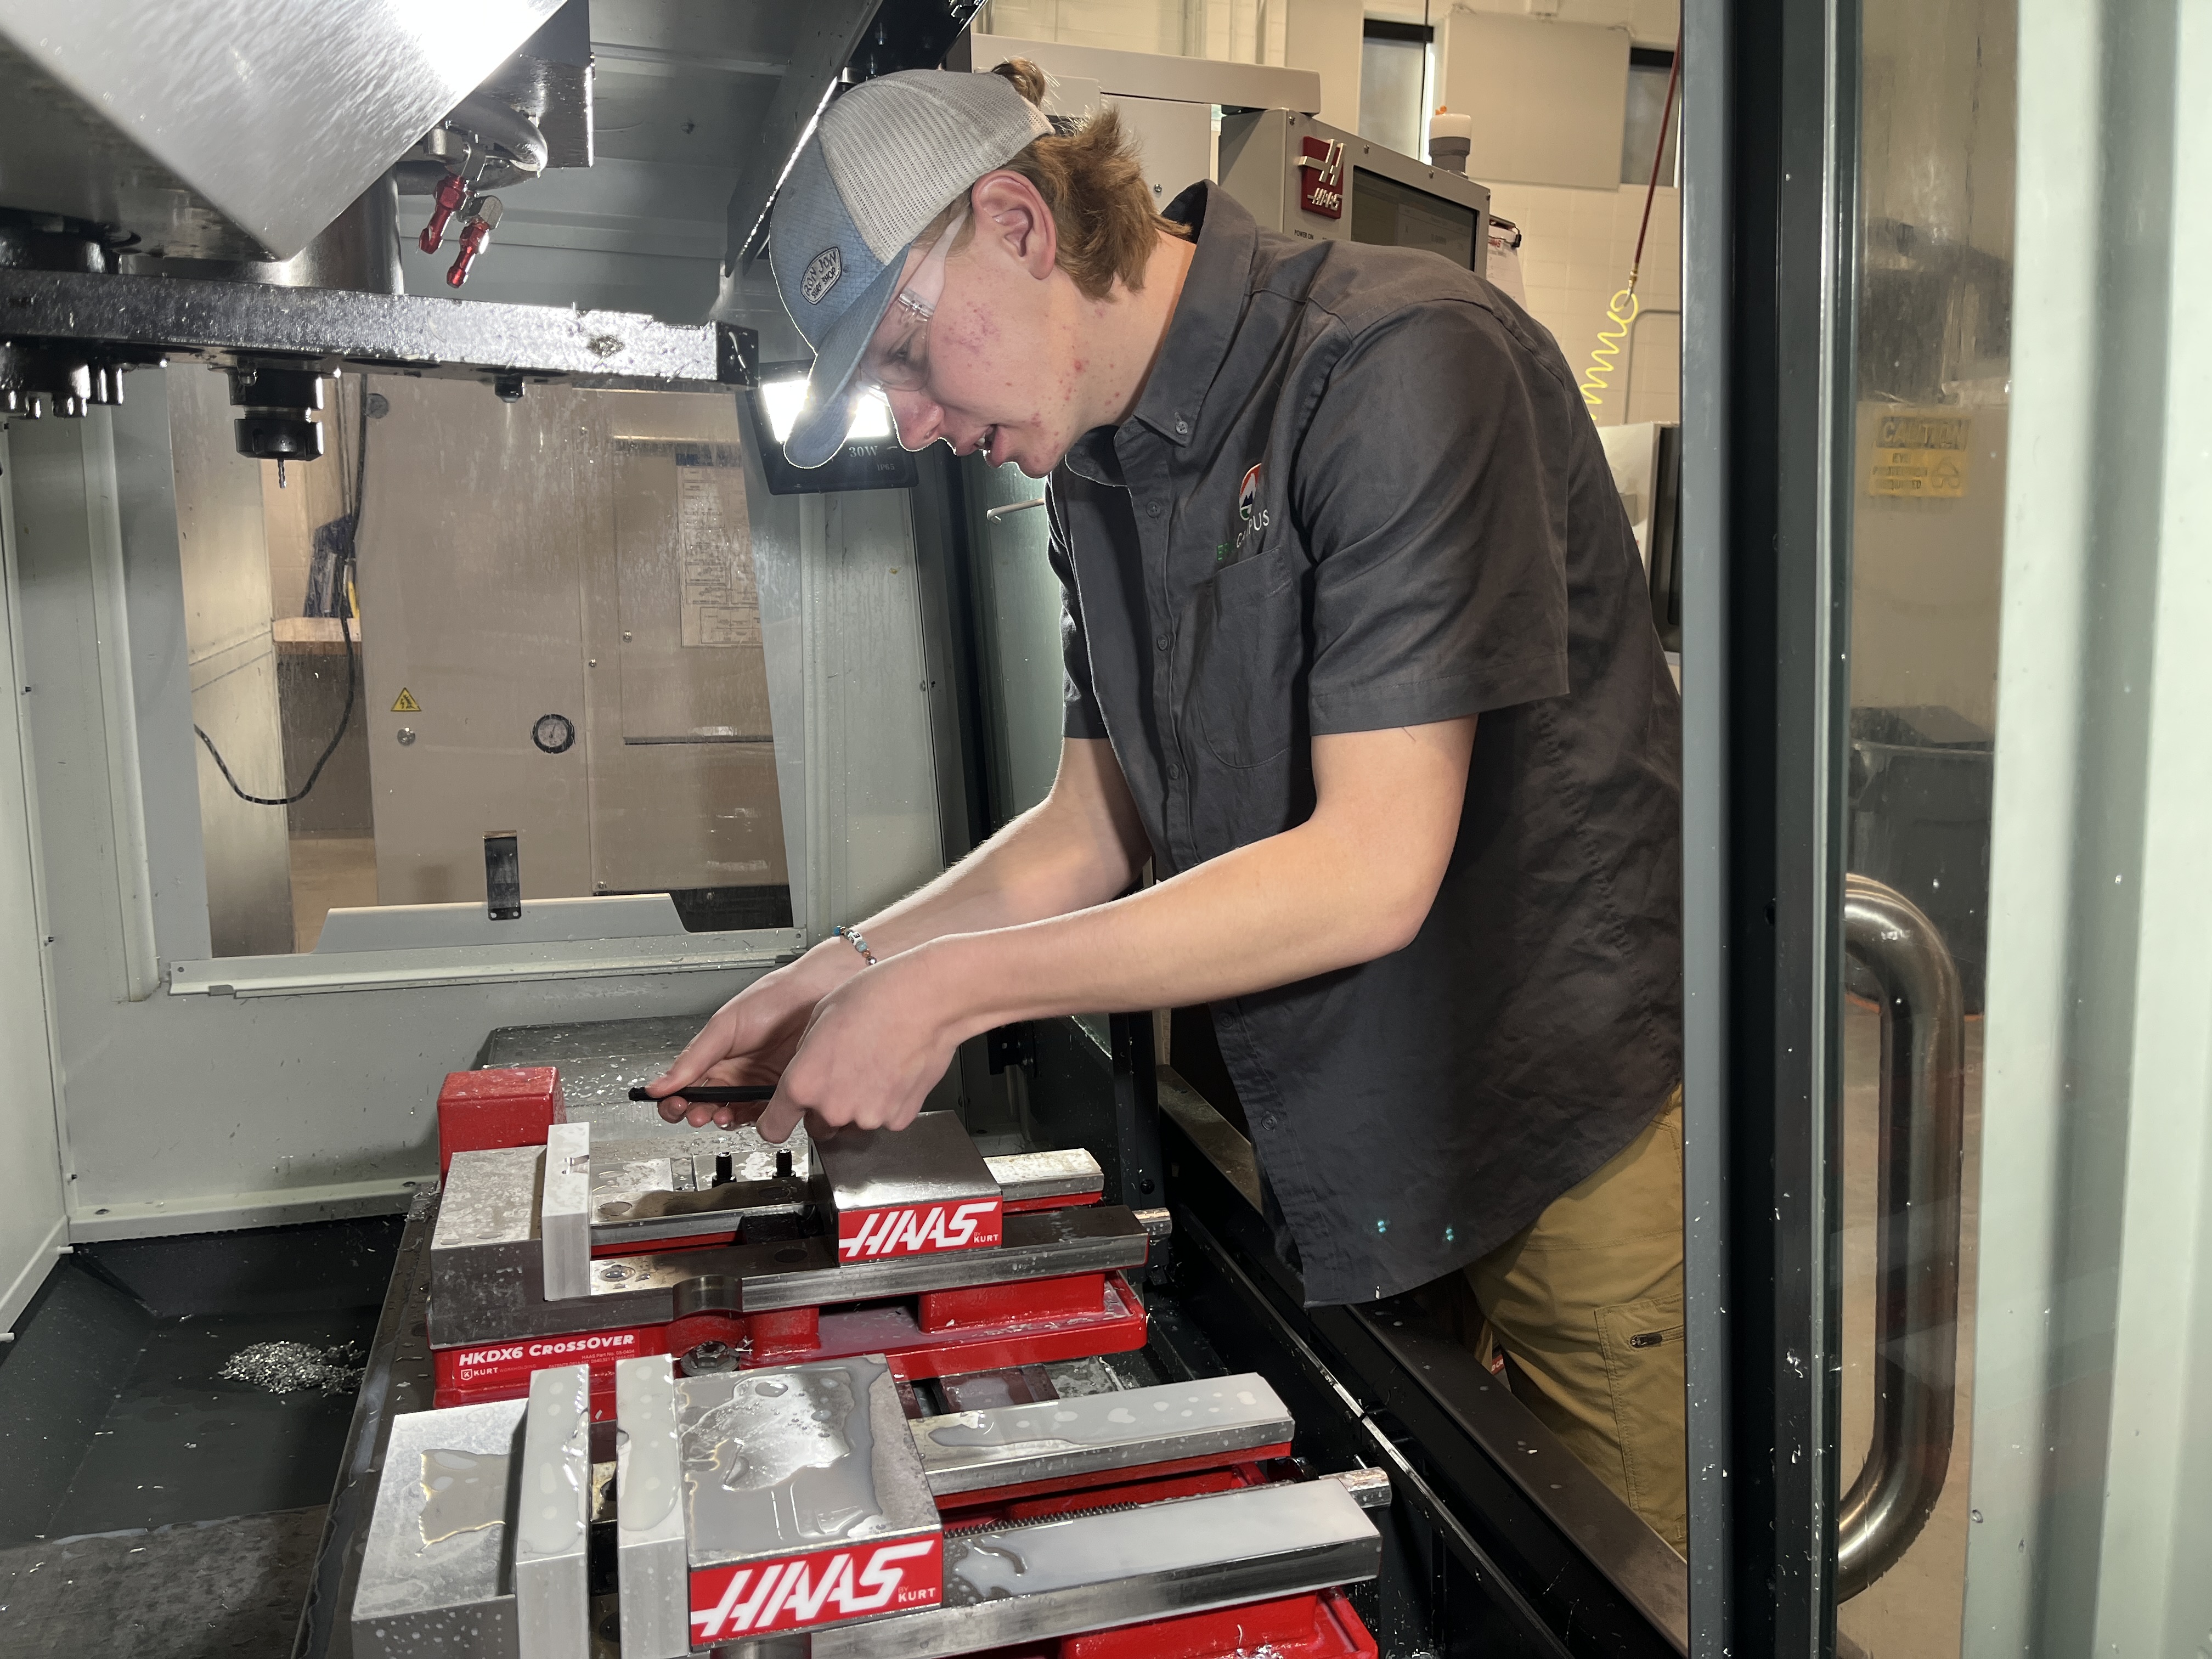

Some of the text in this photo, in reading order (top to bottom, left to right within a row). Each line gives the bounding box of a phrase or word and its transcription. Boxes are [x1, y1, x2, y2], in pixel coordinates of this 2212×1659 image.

[1307, 187, 1343, 211] HAAS
[1294, 229, 1307, 239] POWER
[804, 251, 836, 297] RON JON
[811, 267, 836, 298] SURF SHOP
[849, 445, 878, 458] 30W
[839, 1201, 998, 1257] HAAS
[973, 1234, 999, 1244] KURT
[459, 1346, 523, 1366] HKDX6
[473, 1367, 499, 1376] KURT
[691, 1540, 935, 1638] HAAS
[898, 1585, 909, 1594] BY
[898, 1587, 936, 1603] KURT
